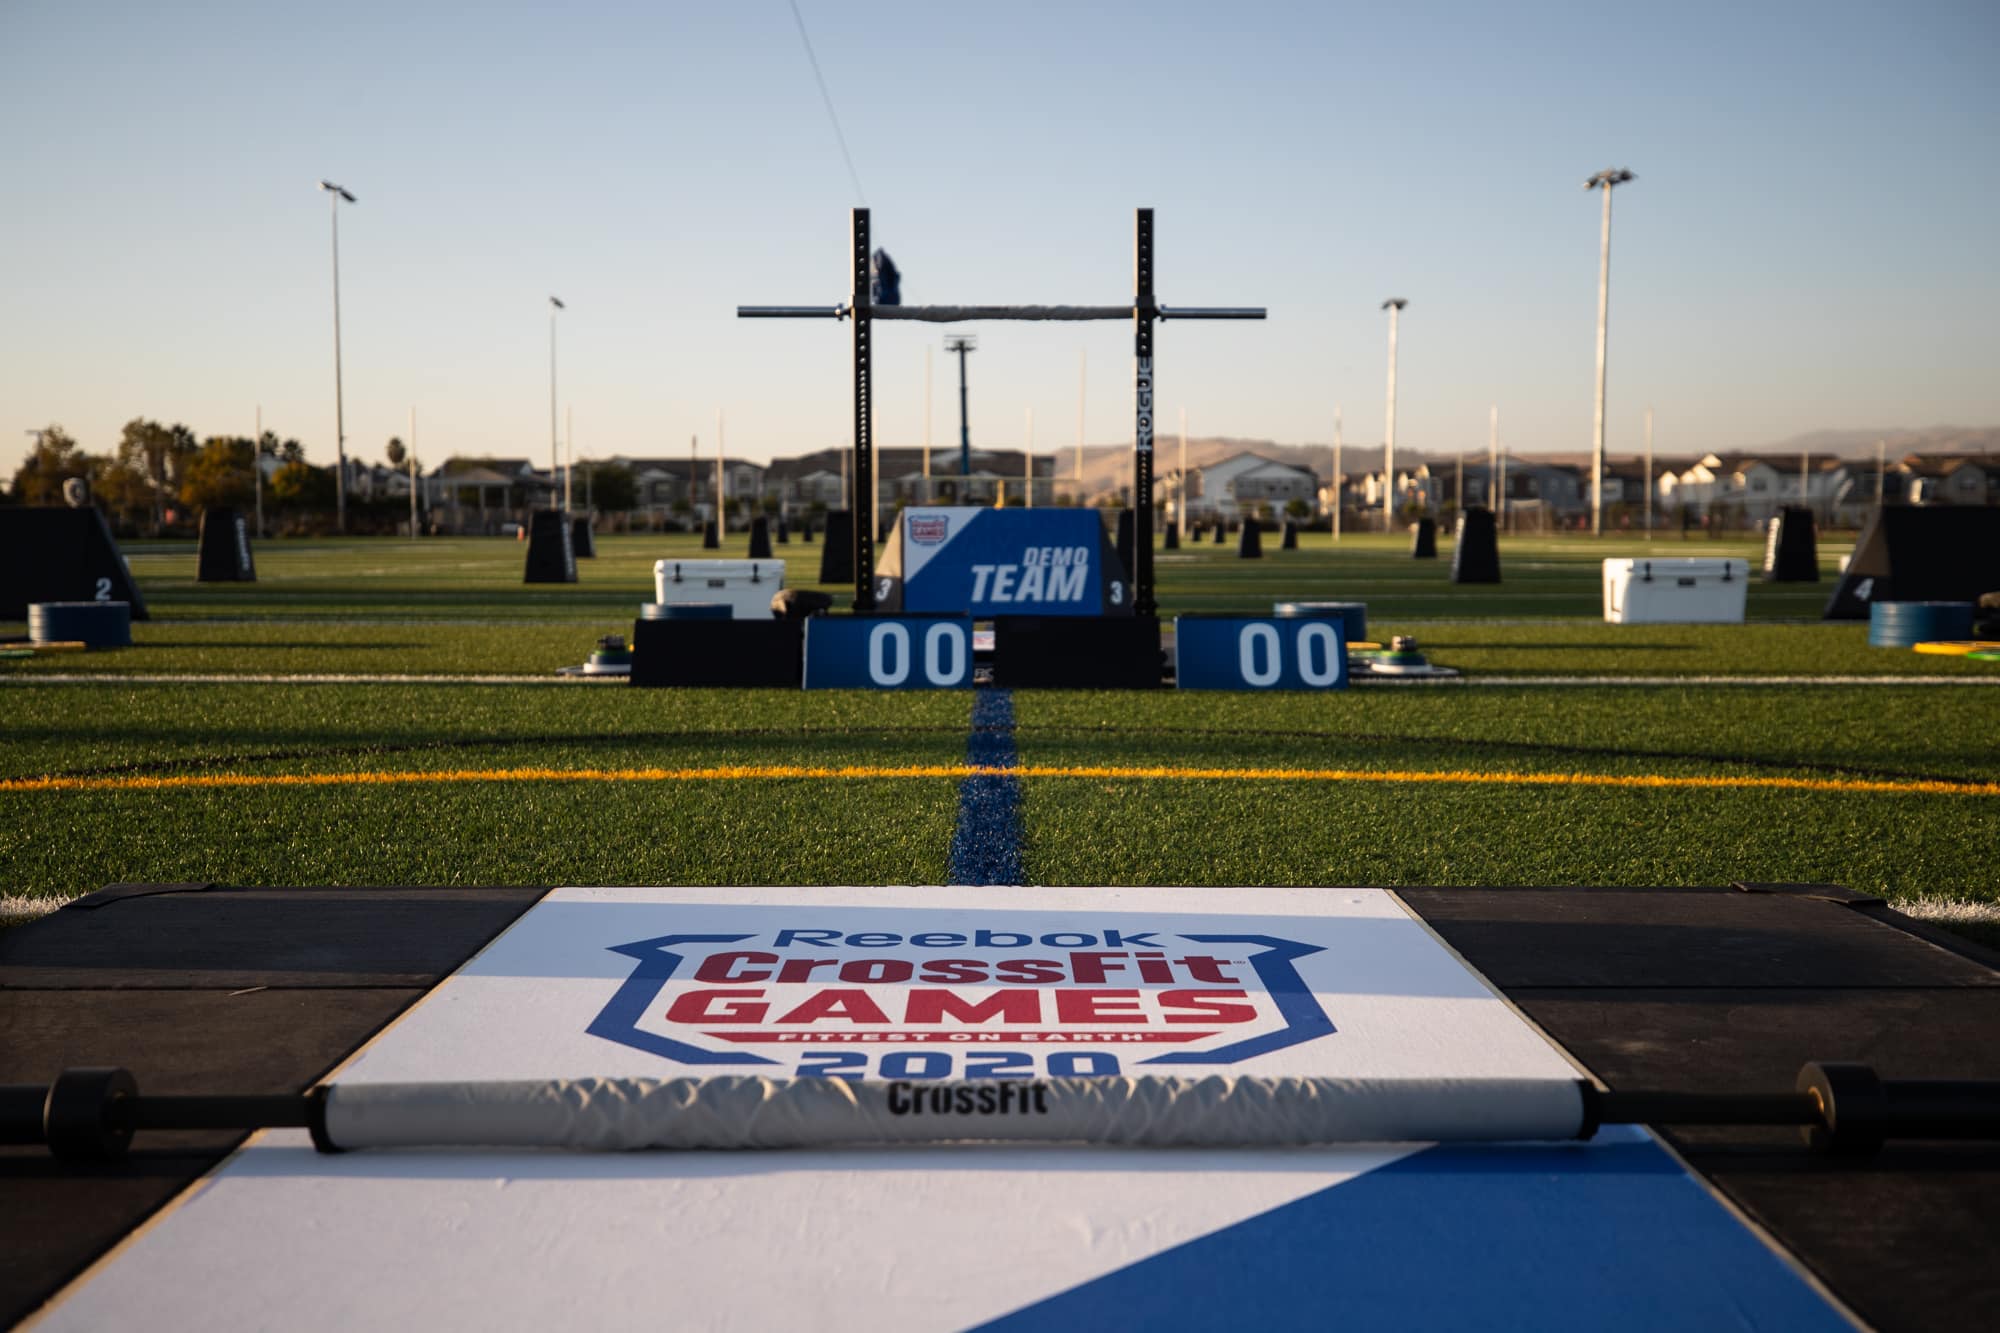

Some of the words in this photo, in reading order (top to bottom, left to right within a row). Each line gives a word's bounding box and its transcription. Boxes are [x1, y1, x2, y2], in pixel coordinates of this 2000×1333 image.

[1137, 357, 1153, 451] ROGUE
[1023, 547, 1089, 567] DEMO
[95, 577, 112, 601] 2
[875, 578, 893, 601] 3
[971, 565, 1089, 602] TEAM
[1110, 580, 1123, 604] 3
[1854, 578, 1874, 601] 4
[773, 929, 1168, 948] Reebok
[694, 951, 1241, 984] CrossFit
[665, 988, 1259, 1024] GAMES
[777, 1032, 931, 1042] FITTEST
[948, 1032, 1000, 1042] ON
[1020, 1032, 1143, 1042] EARTH
[795, 1051, 1122, 1079] 2020
[887, 1081, 1049, 1116] CrossFit
